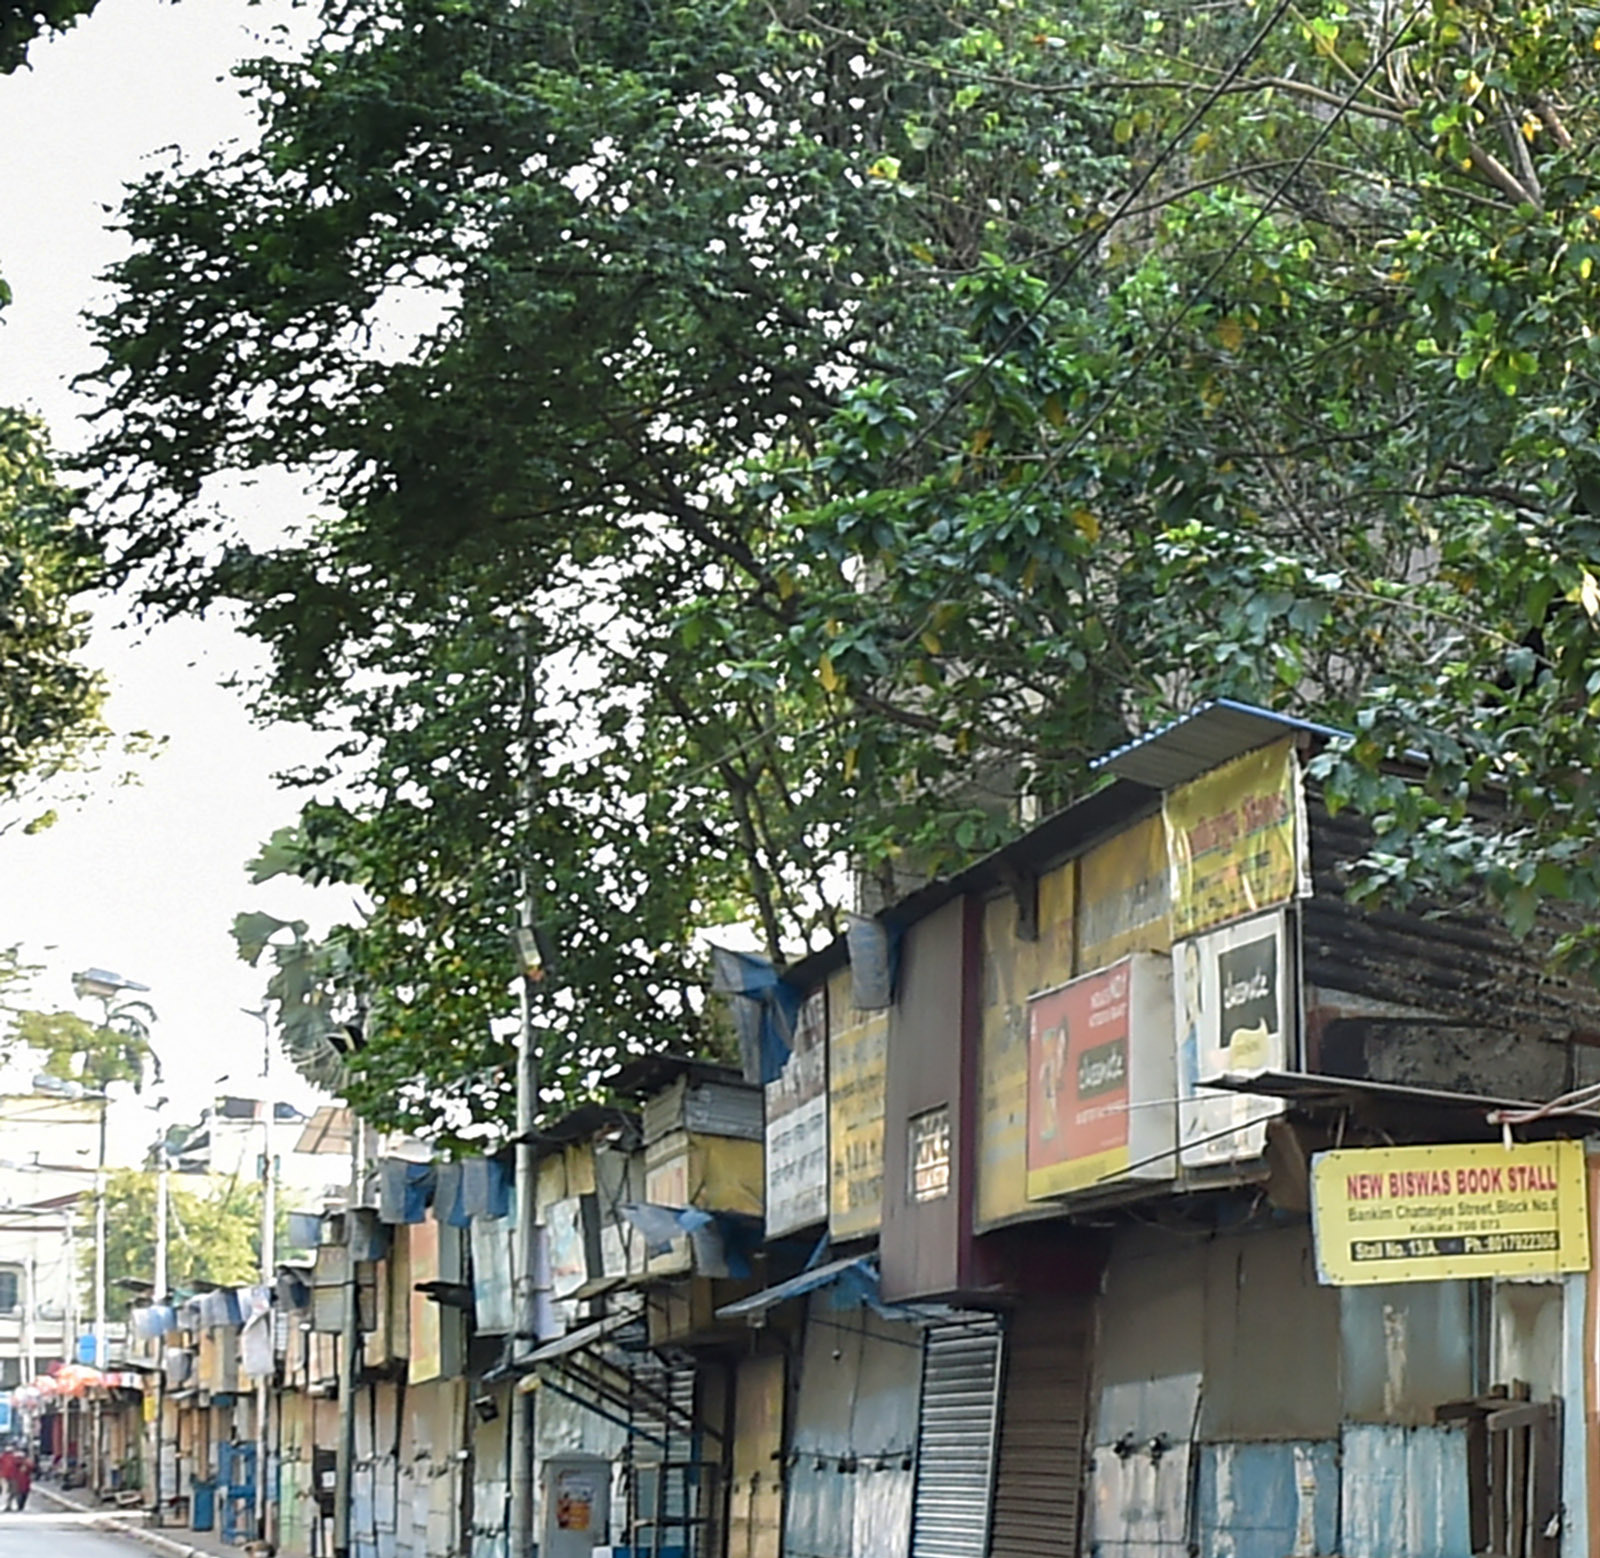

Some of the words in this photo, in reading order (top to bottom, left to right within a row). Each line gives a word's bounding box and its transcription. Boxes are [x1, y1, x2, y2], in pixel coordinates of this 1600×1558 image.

[1347, 1173, 1383, 1200] NEW
[1389, 1170, 1451, 1197] BISWAS
[1457, 1167, 1502, 1195] BOOK
[1508, 1165, 1558, 1192] STALL
[1348, 1206, 1393, 1222] Bankim
[1396, 1203, 1454, 1221] Chatterjee
[1496, 1199, 1528, 1215] Block
[1409, 1221, 1453, 1234] Kolkata
[1355, 1241, 1383, 1260] Stall
[1385, 1240, 1404, 1258] No.
